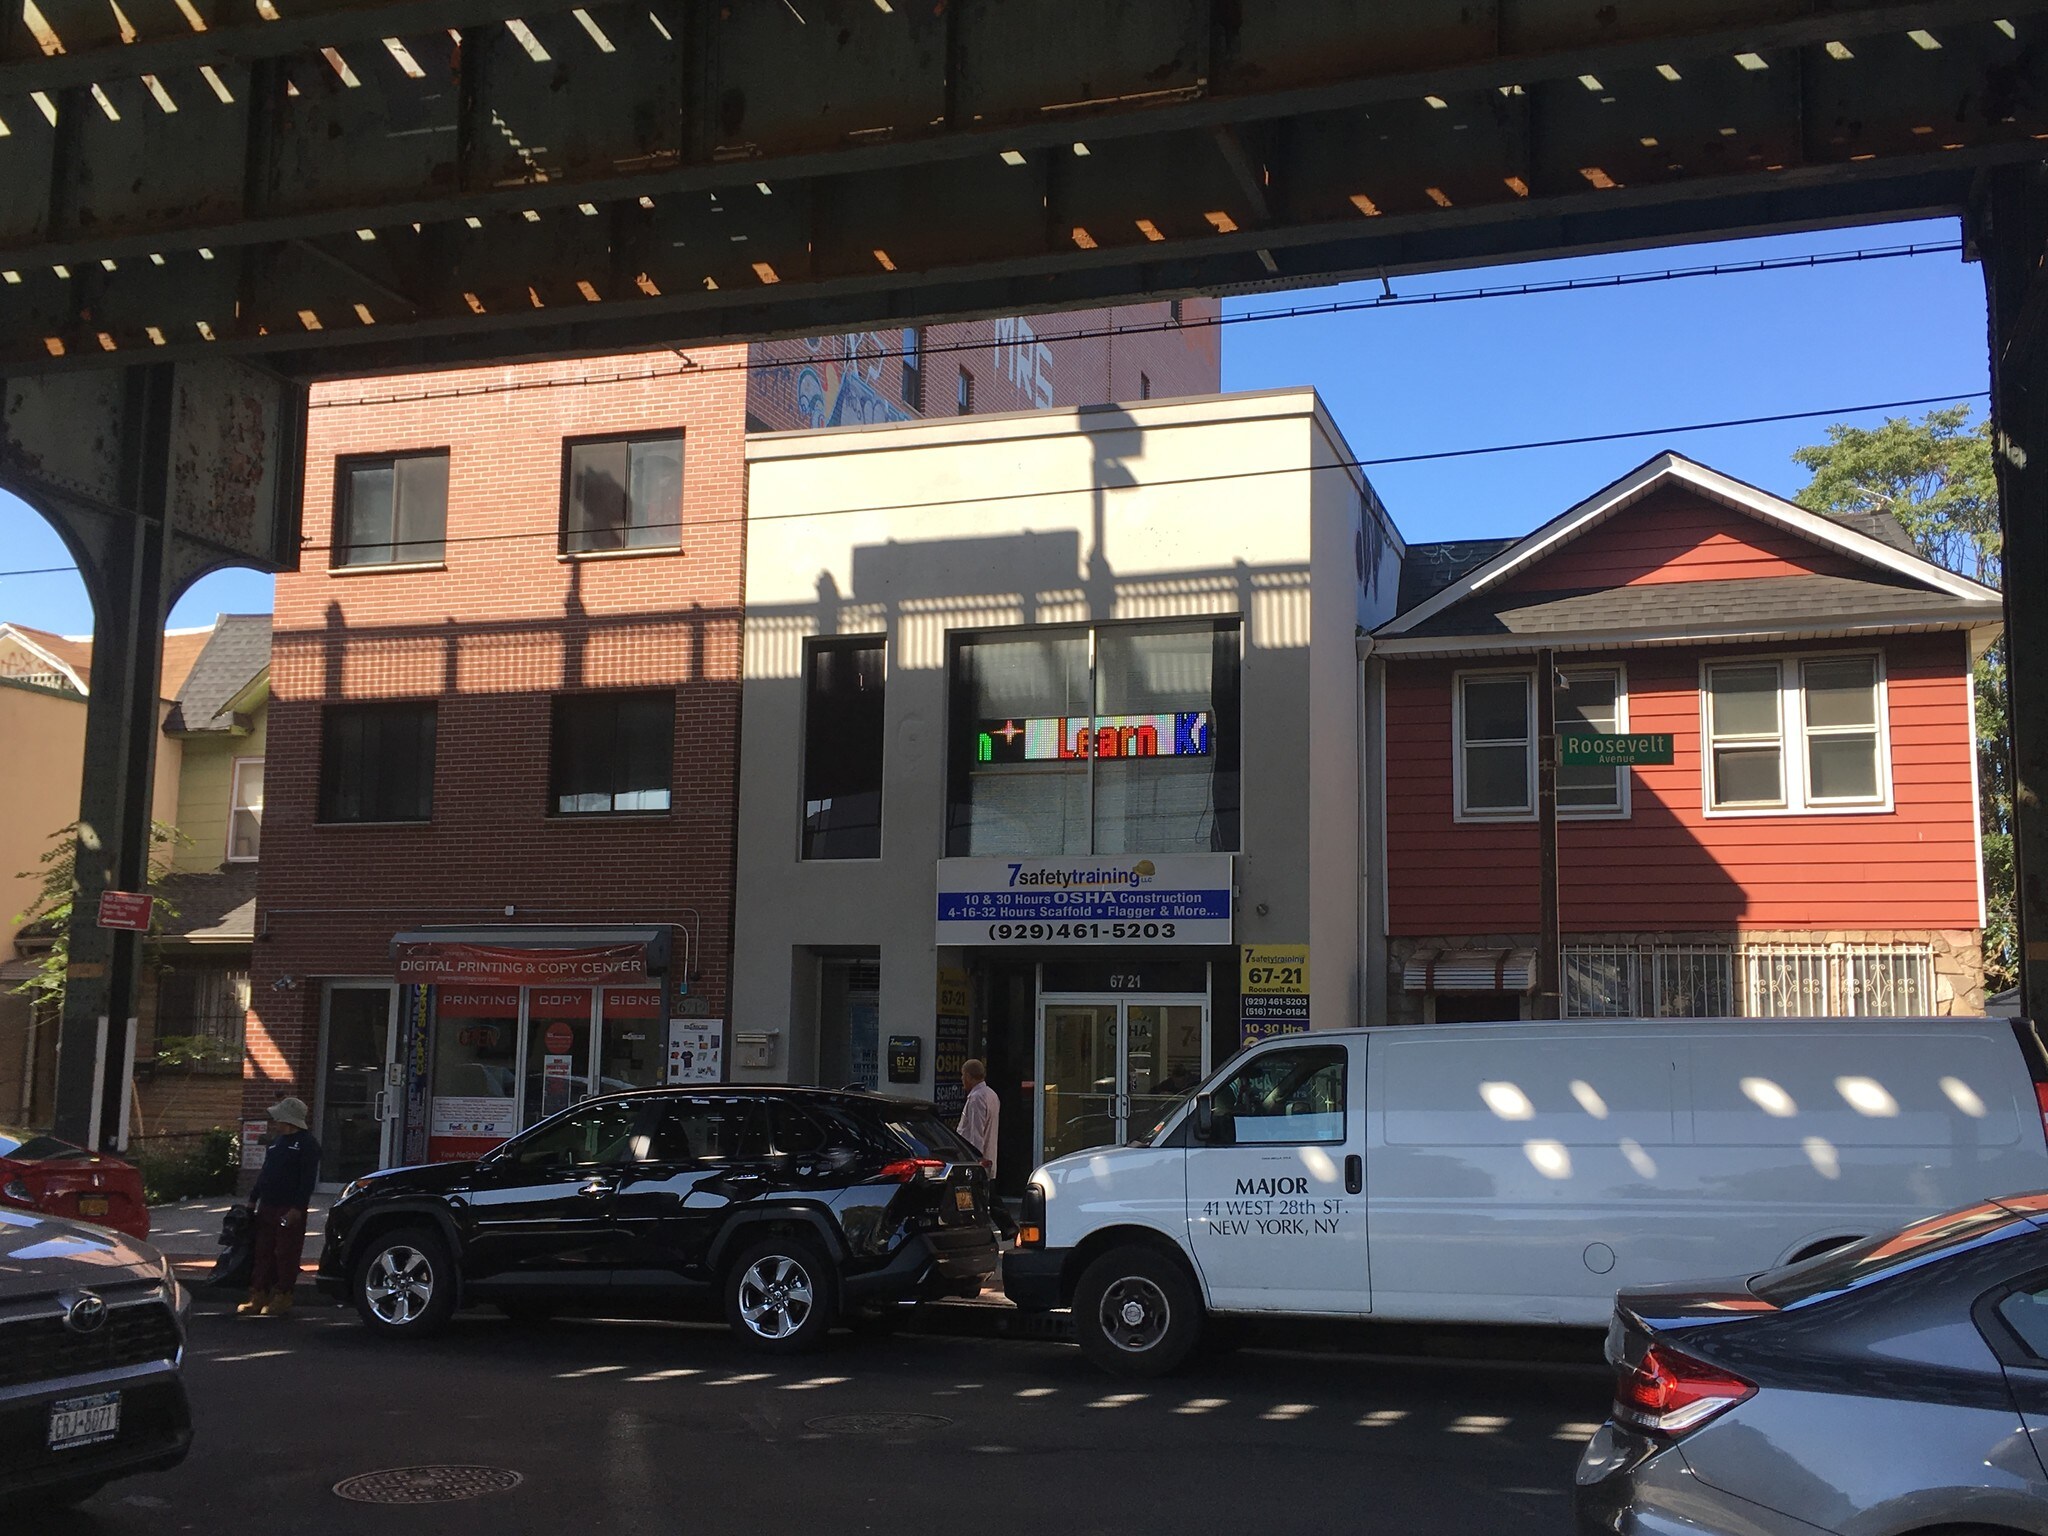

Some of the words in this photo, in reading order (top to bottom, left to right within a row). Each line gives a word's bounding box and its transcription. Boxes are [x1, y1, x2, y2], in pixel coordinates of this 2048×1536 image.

[1059, 717, 1157, 758] Learn
[1568, 736, 1665, 754] Roosevelt
[1599, 755, 1635, 763] Avenue
[1007, 864, 1140, 888] 7safetytraining
[964, 895, 979, 905] 10
[983, 895, 992, 905] &
[996, 895, 1011, 905] 30
[1015, 894, 1051, 904] Hours
[1054, 891, 1117, 904] OSHA
[1120, 893, 1202, 904] Construction
[948, 907, 996, 918] 4-16-32
[1000, 906, 1035, 917] Hours
[1039, 906, 1091, 917] Scaffold
[1108, 905, 1156, 918] Flagger
[1159, 906, 1169, 916] &
[1173, 906, 1219, 916] More...
[988, 923, 1176, 940] (929)461-5203
[1245, 949, 1305, 964] 7safetytraining
[400, 961, 454, 971] DIGITAL
[457, 962, 523, 973] PRINTING
[525, 963, 535, 973] &
[538, 962, 578, 973] COPY
[581, 961, 641, 973] CENTER
[1248, 968, 1302, 984] 67-21
[443, 995, 517, 1006] PRINTING
[539, 995, 583, 1006] COPY
[610, 995, 661, 1006] SIGNS
[942, 990, 965, 1006] 67-21
[1245, 997, 1267, 1006] (929)
[1268, 998, 1307, 1006] 461-5203
[1267, 1008, 1307, 1016] 710-0184
[1108, 1025, 1149, 1036] OHA
[1245, 1023, 1279, 1034] 10-30
[1282, 1024, 1304, 1034] Hrs
[415, 1032, 426, 1075] COPY
[896, 1056, 916, 1066] 67-21
[1235, 1177, 1309, 1197] MAJOR
[1203, 1201, 1219, 1215] 41
[1226, 1200, 1273, 1215] WEST
[1279, 1199, 1316, 1215] 28th
[1323, 1199, 1349, 1214] ST.
[1209, 1220, 1249, 1235] NEW
[1256, 1219, 1309, 1236] YORK,
[1315, 1219, 1340, 1234] NY
